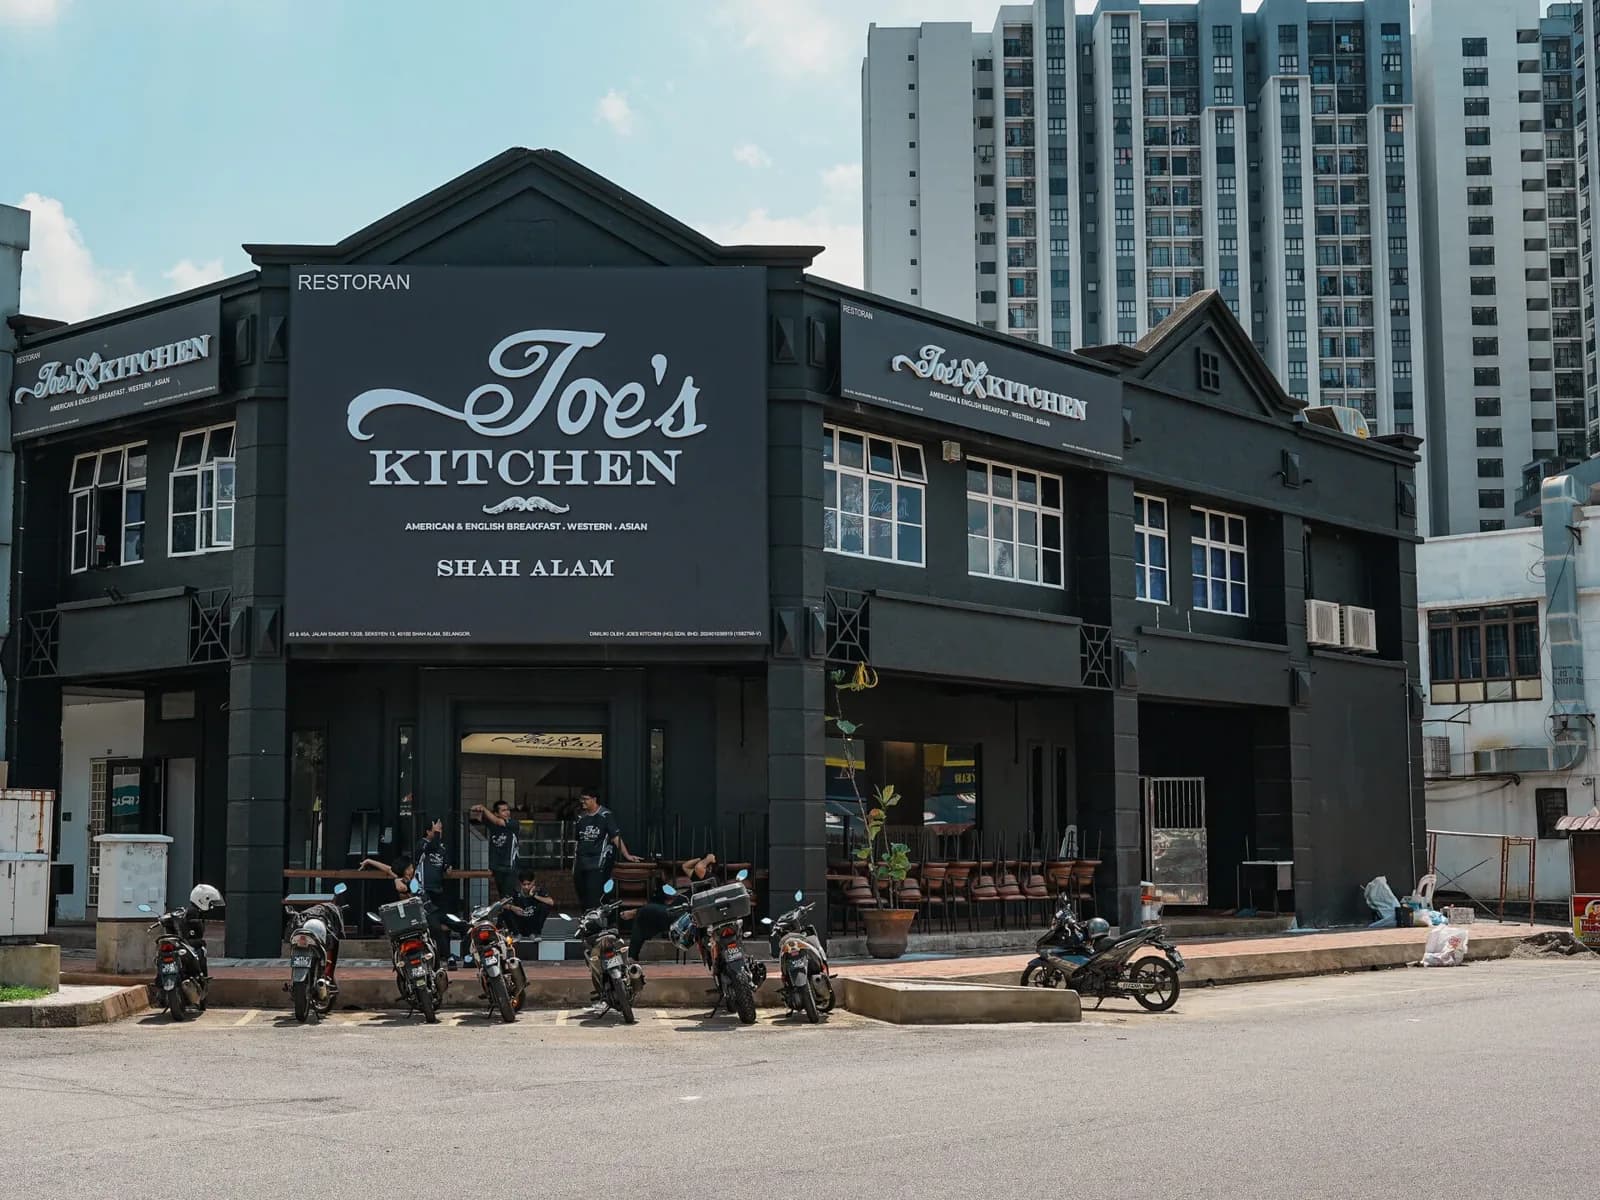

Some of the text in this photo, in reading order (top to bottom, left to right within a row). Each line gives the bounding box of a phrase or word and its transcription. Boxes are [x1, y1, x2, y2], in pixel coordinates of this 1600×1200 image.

[298, 274, 411, 291] RESTORAN
[842, 304, 873, 320] RESTORAN
[15, 334, 211, 404] Joe's KITCHEN
[16, 351, 41, 365] RESTORAN
[50, 400, 74, 412] AMERICAN
[78, 395, 98, 407] ENGLISH
[98, 387, 126, 401] BREAKFAST
[128, 382, 152, 394] WESTERN
[154, 377, 170, 387] ASIAN
[347, 329, 707, 440] Joe's
[892, 344, 1088, 421] Joe's KITCHEN
[929, 391, 956, 403] AMERICAN
[961, 398, 981, 409] ENGLISH
[981, 403, 1009, 417] BREAKFAST
[1011, 411, 1034, 423] WESTERN
[1036, 417, 1050, 427] ASIAN
[369, 450, 682, 486] KITCHEN
[405, 522, 648, 531] AMERICAN & ENGLISH BREAKFAST WESTERN ASIAN
[437, 559, 615, 577] SHAH ALAM
